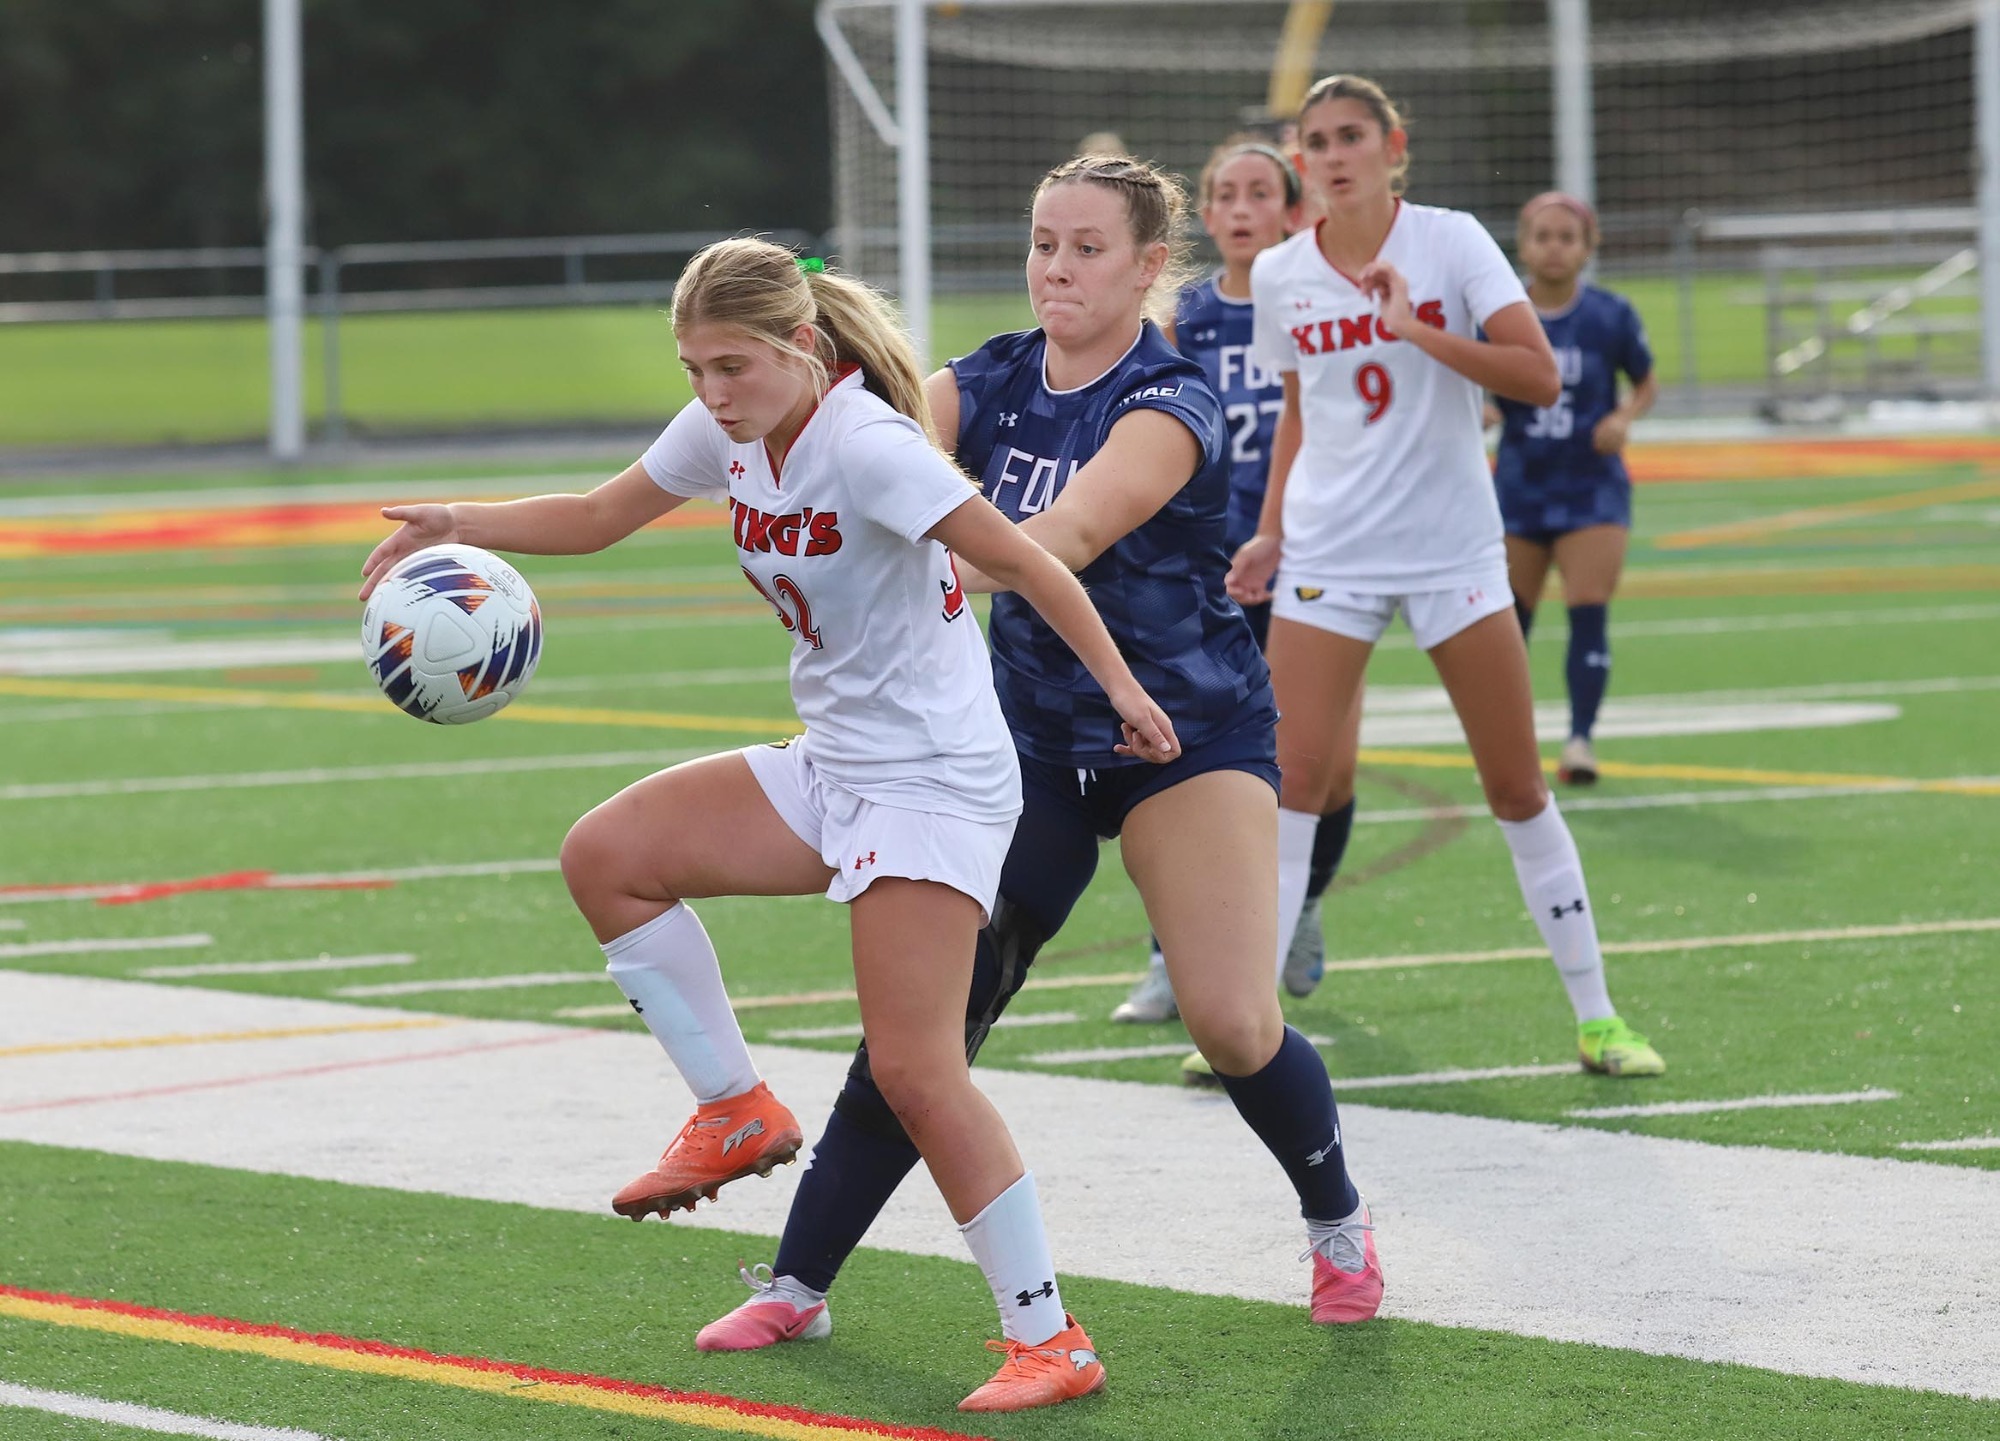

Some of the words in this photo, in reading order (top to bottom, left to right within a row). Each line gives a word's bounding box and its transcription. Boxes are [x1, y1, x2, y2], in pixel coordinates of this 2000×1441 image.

[1291, 300, 1446, 355] KINS
[1353, 360, 1395, 427] 9
[729, 496, 843, 557] ING'S
